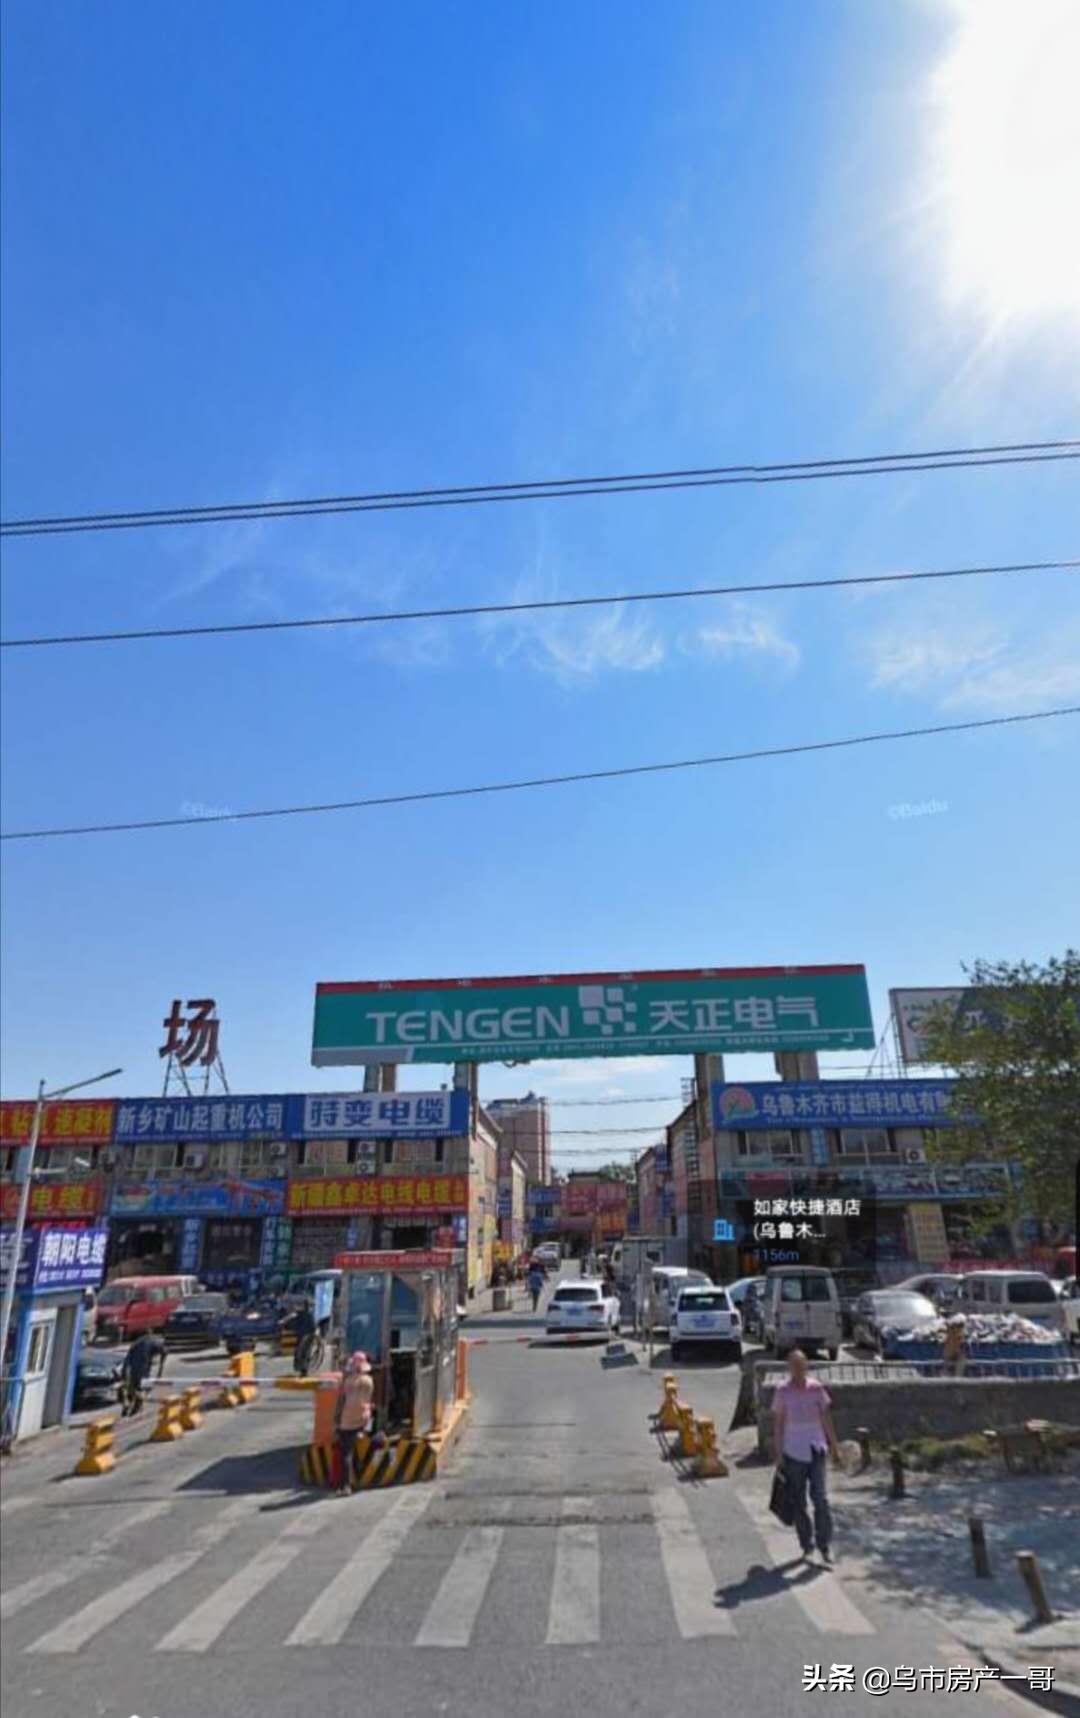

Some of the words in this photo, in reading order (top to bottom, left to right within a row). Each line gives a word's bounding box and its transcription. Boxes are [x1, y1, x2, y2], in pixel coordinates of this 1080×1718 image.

[159, 998, 220, 1067] 场
[365, 1005, 570, 1043] TENGEN
[648, 996, 819, 1033] 天正电气
[117, 1102, 284, 1134] 新乡矿山起重机公司
